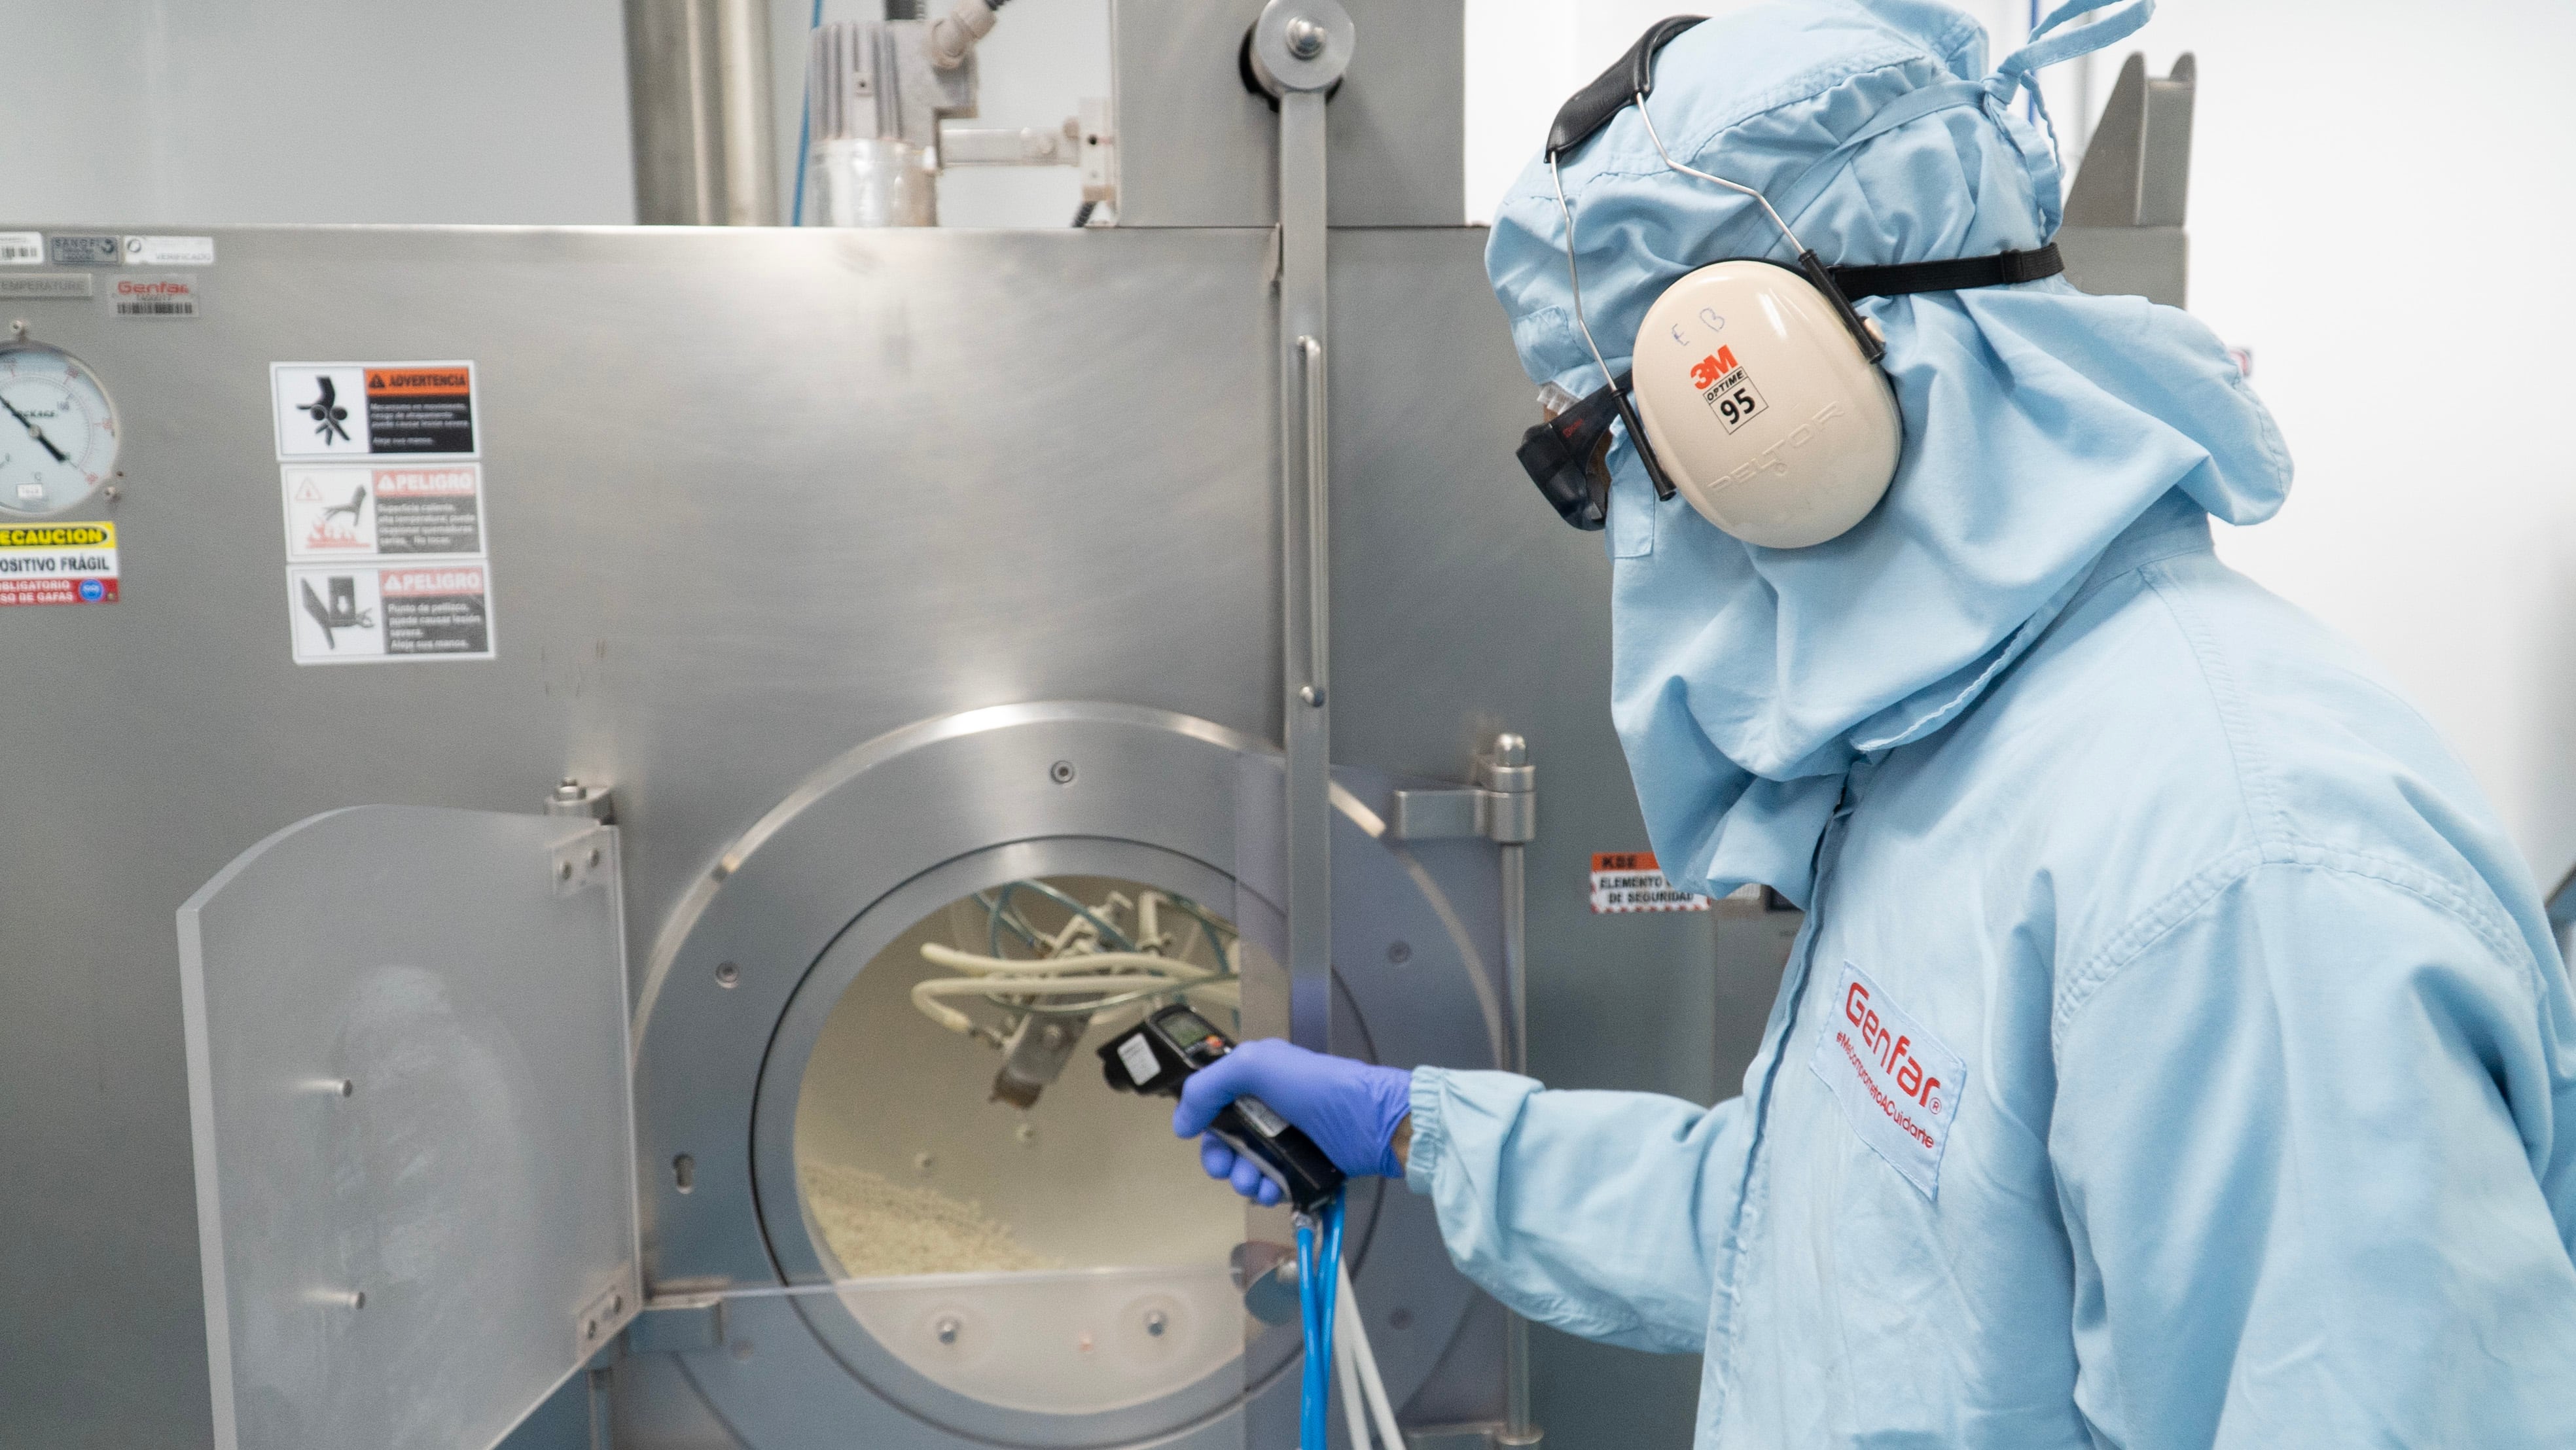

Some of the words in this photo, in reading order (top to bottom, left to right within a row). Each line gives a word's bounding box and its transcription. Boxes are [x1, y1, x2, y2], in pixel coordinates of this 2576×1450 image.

[1690, 344, 1738, 389] 3M
[389, 375, 466, 386] ADVERTENCIA
[1707, 370, 1744, 401] OPTIME
[1720, 387, 1756, 425] 95
[396, 472, 472, 489] PELIGRO
[0, 557, 56, 572] OSITIVO
[61, 553, 109, 571] FRÁGIL
[0, 580, 70, 591] BLIGATORIO
[403, 573, 480, 590] PELIGRO
[19, 592, 35, 603] DE
[37, 591, 73, 601] GAFAS
[1600, 876, 1663, 888] ELEMENTO
[1609, 893, 1622, 904] DE
[1628, 891, 1694, 903] SEGURIDAD
[1836, 1031, 1935, 1149] #MeComprometoACuidarte
